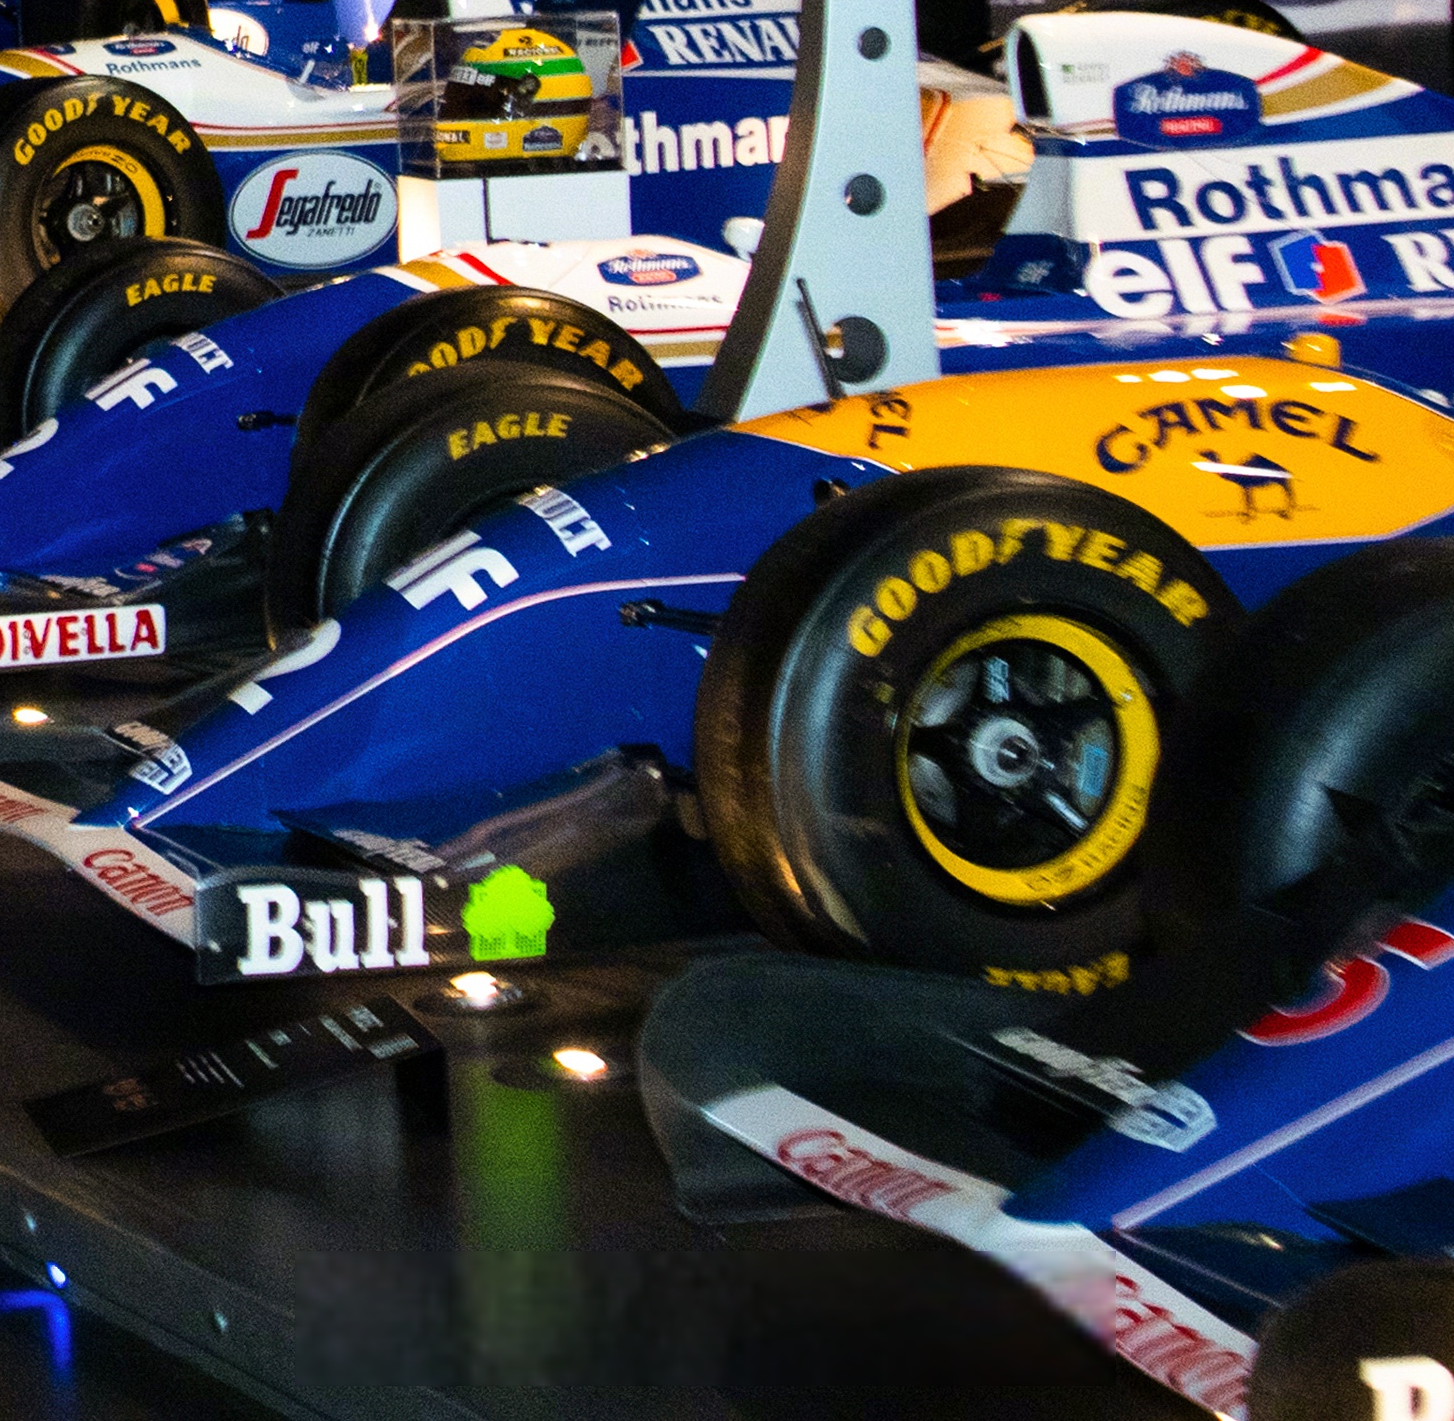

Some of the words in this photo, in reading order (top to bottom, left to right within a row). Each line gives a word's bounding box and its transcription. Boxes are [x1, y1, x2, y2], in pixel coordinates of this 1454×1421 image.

[105, 55, 203, 77] Rothmans
[124, 273, 218, 308] EAGLE
[1084, 233, 1267, 319] elf
[447, 411, 573, 462] EAGLE
[1094, 399, 1380, 474] CAMEL
[237, 875, 431, 977] Bull
